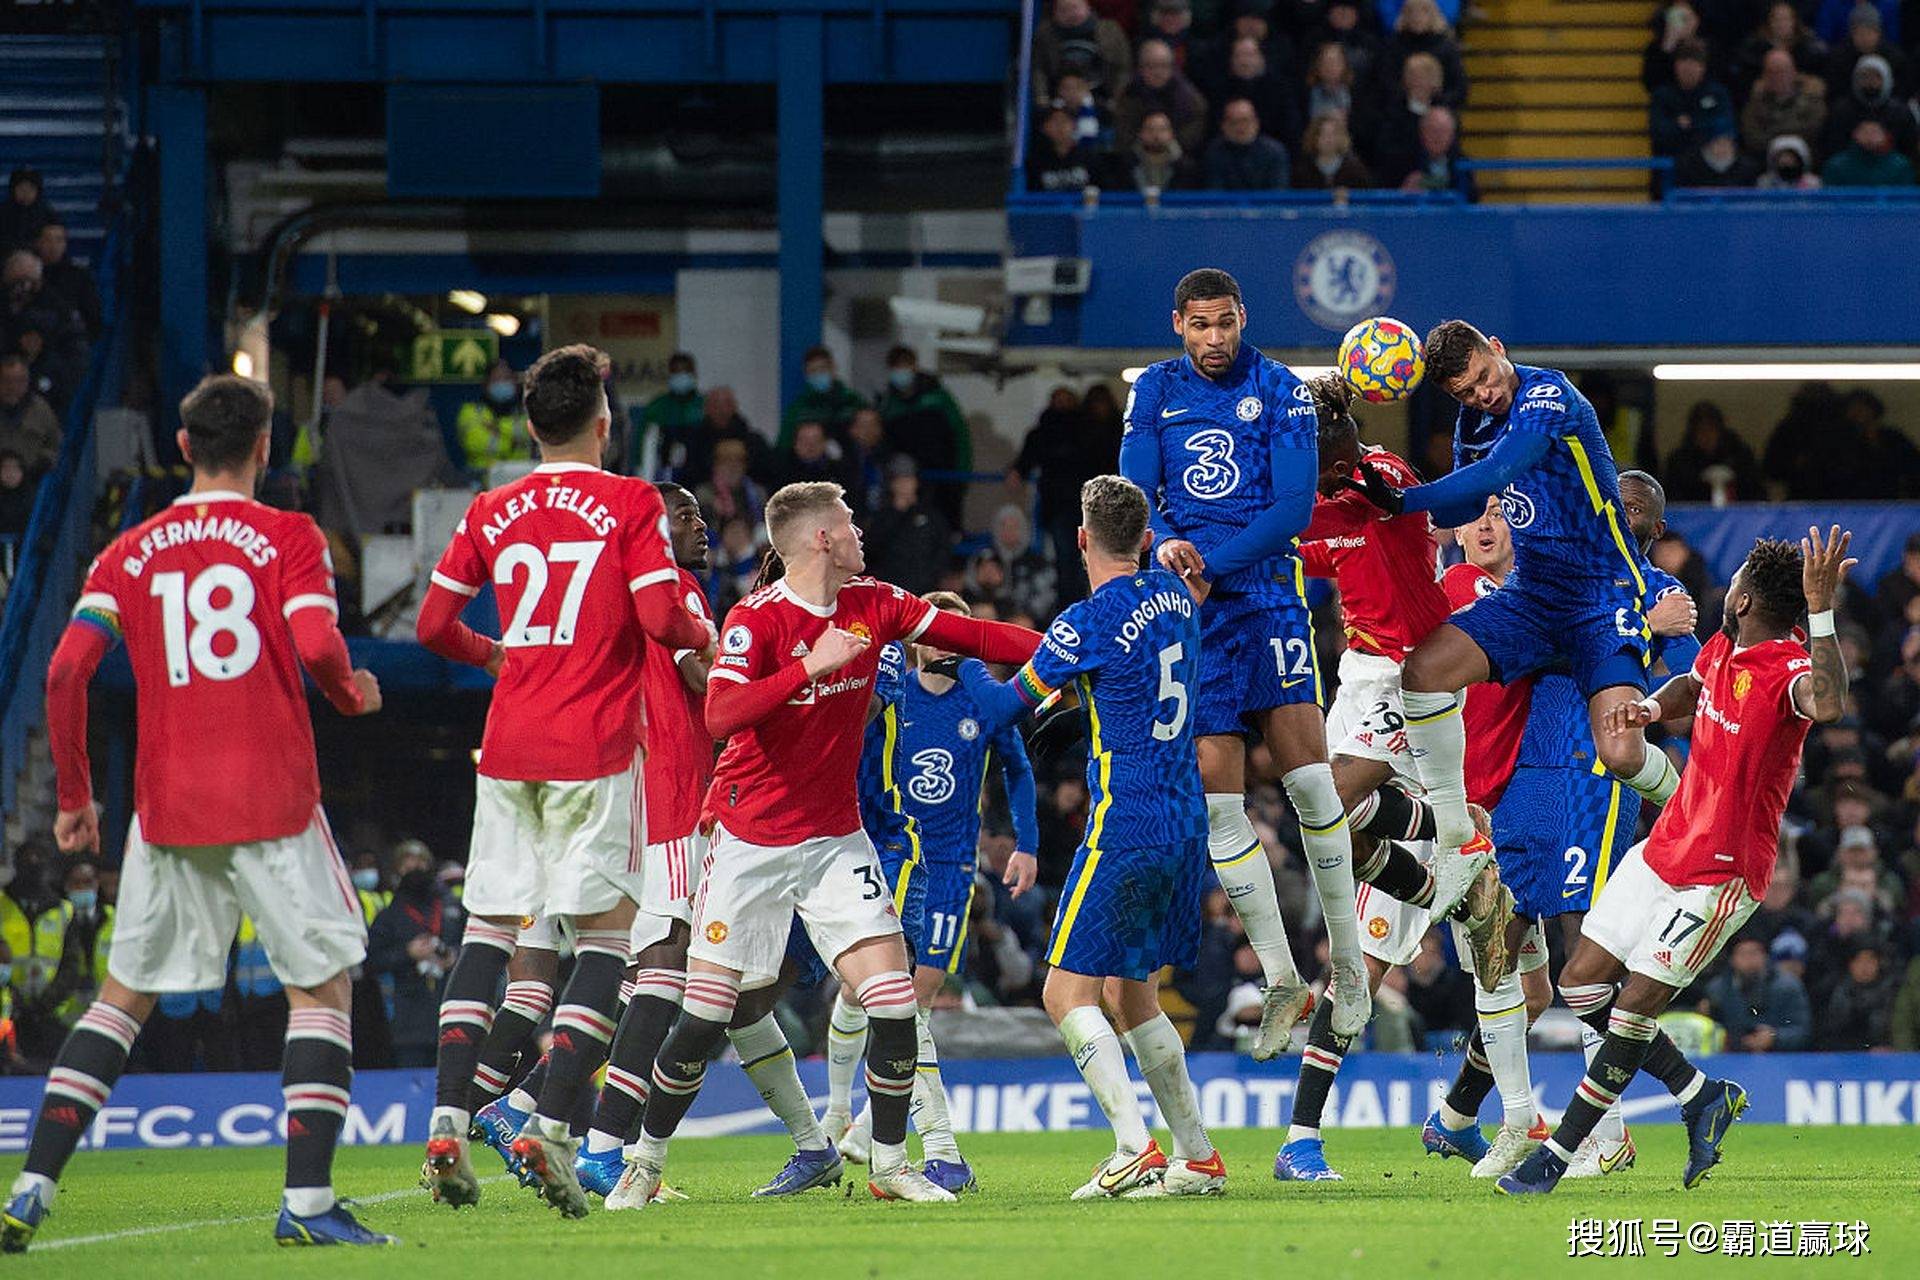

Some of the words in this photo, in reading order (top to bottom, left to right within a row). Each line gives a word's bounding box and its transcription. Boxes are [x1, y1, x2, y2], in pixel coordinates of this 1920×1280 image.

[481, 488, 539, 547] ALEX
[545, 486, 619, 538] TELLES
[122, 515, 279, 579] B.FERNANDES
[493, 539, 607, 648] 27
[149, 562, 262, 688] 18
[1114, 590, 1192, 654] JORGINHO
[1269, 637, 1313, 677] 12
[1151, 641, 1189, 742] 5
[1563, 845, 1589, 885] 2
[930, 911, 958, 949] 11
[1658, 907, 1707, 949] 17
[0, 1105, 407, 1149] EFC.CM
[1785, 1080, 1920, 1126] NIK
